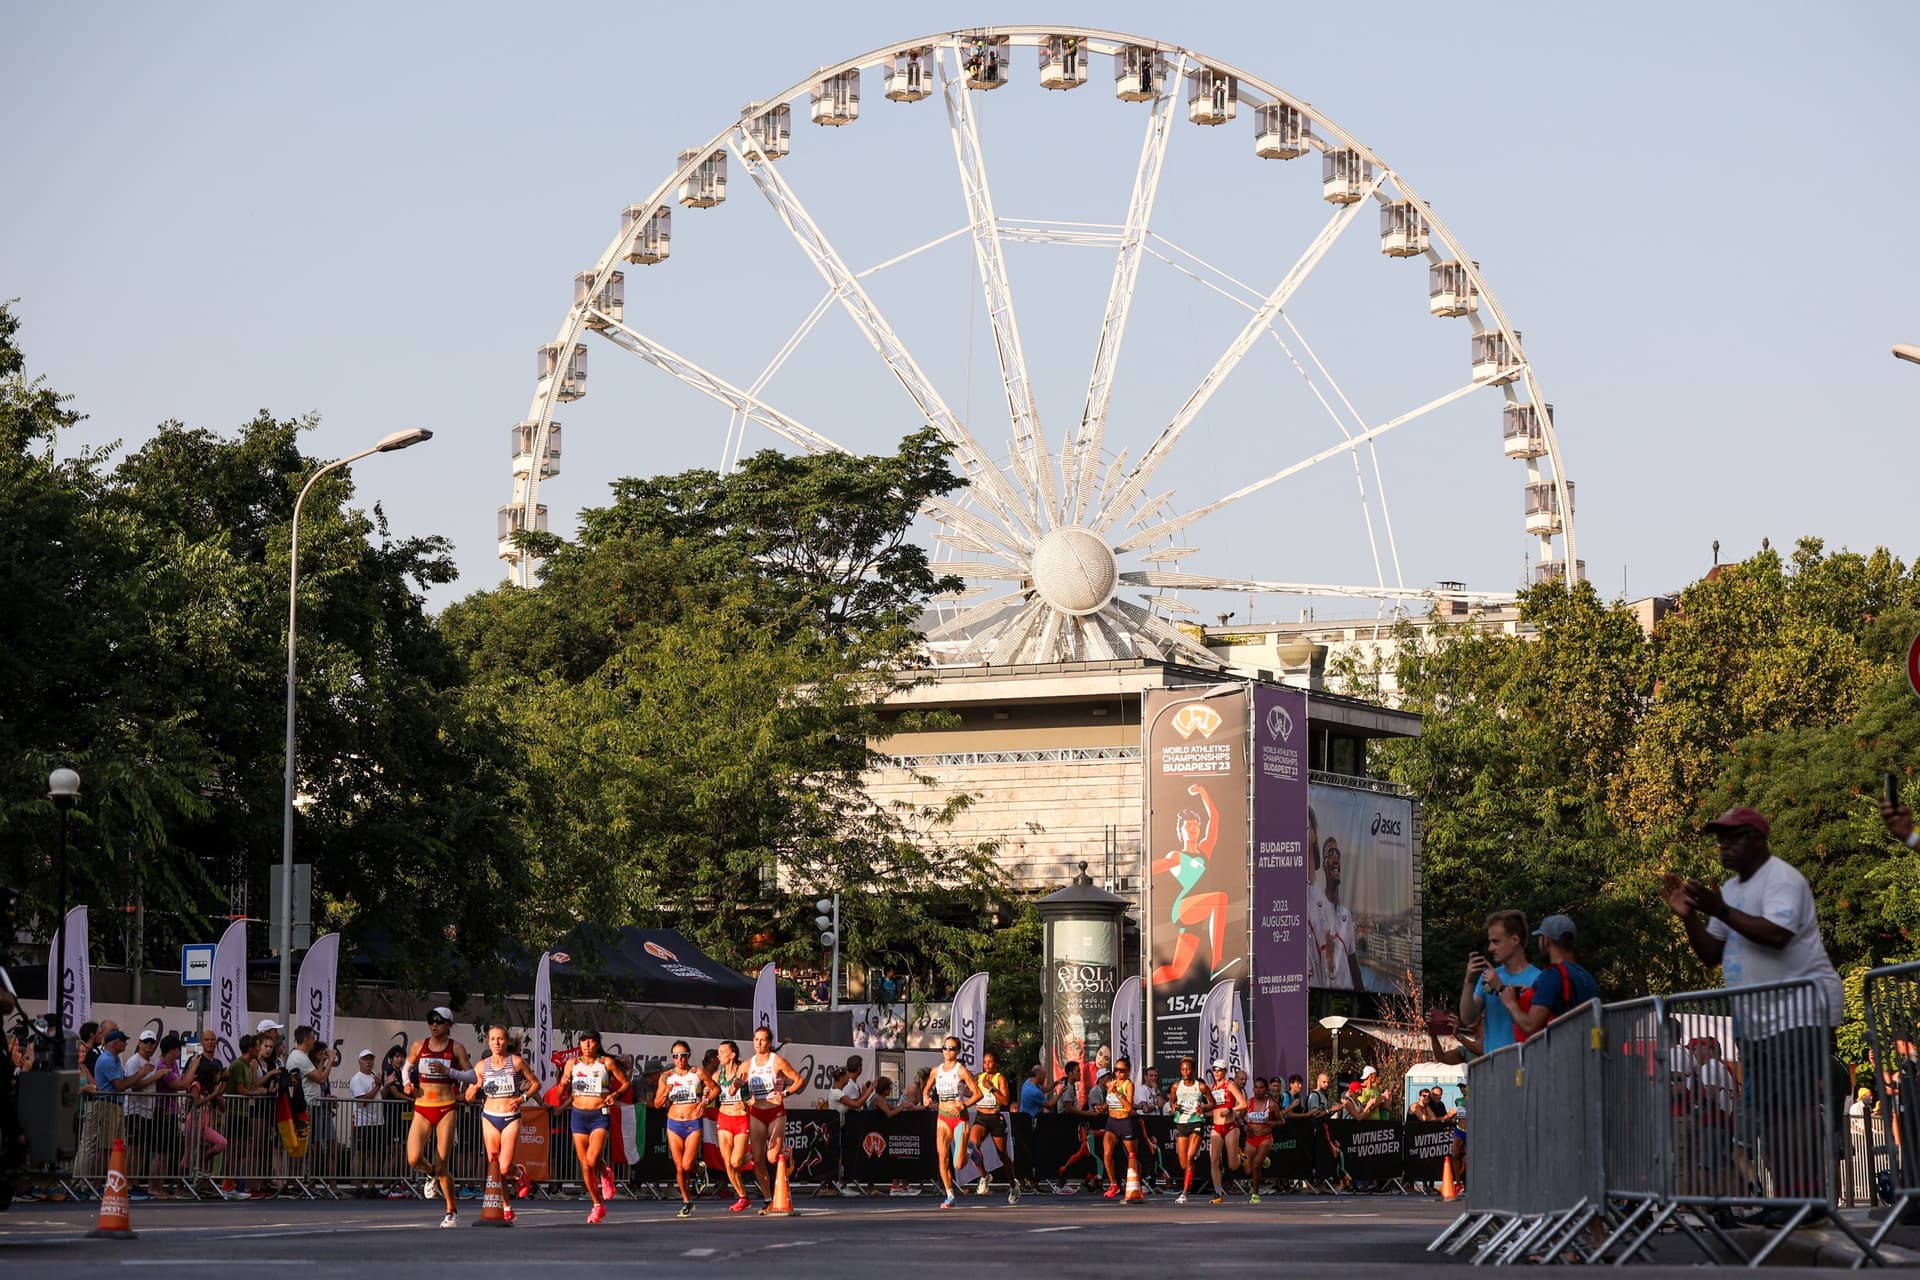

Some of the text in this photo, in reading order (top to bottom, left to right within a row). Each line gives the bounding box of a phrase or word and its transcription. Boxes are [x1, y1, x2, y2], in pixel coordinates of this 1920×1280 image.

[1162, 744, 1231, 754] WORLD ATHLETICS
[1263, 745, 1298, 757] WORLD ATHLETICS
[1162, 752, 1231, 763] CHAMPIONSHIPS
[1262, 754, 1298, 766] CHAMPIONSHIPS
[1162, 761, 1231, 773] BUDAPEST 23
[1263, 764, 1299, 776] BUDAPEST 23
[1260, 841, 1301, 853] BUDAPESTI
[1258, 854, 1303, 868] ATLÉTIKAI VB
[1272, 900, 1288, 912] 2023.
[1261, 915, 1300, 927] AUGUSZTUS
[220, 976, 233, 1037] asics
[962, 1018, 975, 1066] asics
[1120, 1020, 1129, 1056] sics
[1352, 1129, 1395, 1145] WITNESS
[1357, 1141, 1400, 1158] WONDER
[1409, 1144, 1453, 1159] THE WONDE
